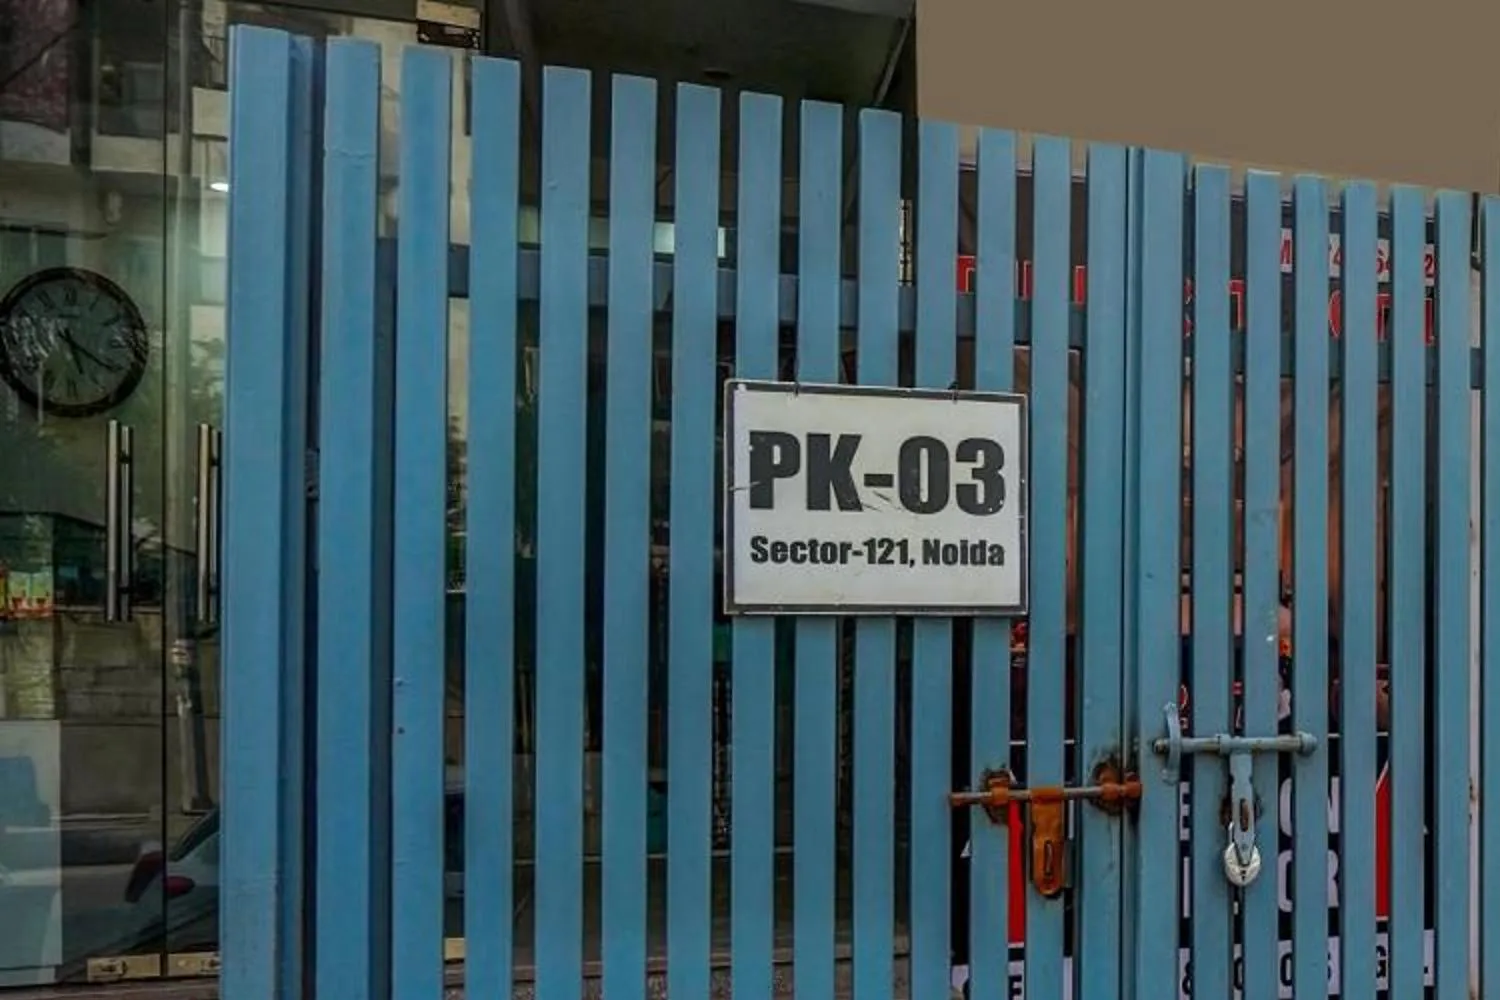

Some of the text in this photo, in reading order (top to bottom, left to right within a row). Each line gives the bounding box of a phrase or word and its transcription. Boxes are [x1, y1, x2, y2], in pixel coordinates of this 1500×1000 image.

[749, 430, 1006, 516] PK-03
[750, 535, 1005, 569] Sector-121, Noida
